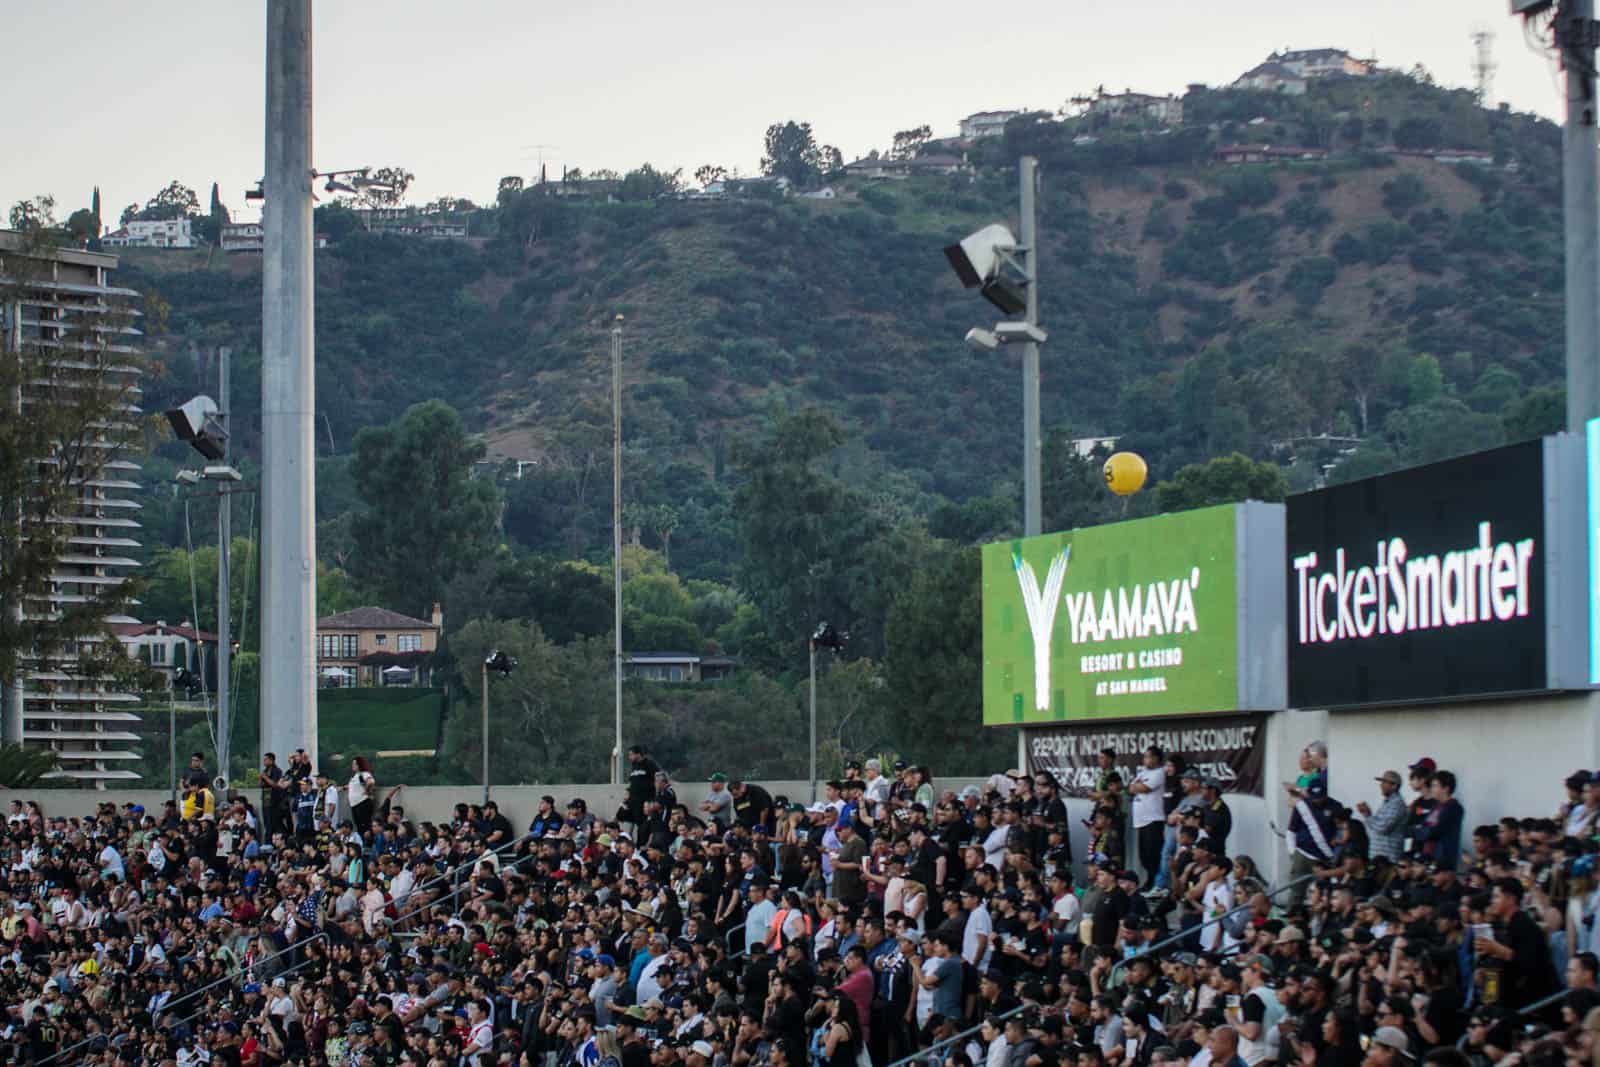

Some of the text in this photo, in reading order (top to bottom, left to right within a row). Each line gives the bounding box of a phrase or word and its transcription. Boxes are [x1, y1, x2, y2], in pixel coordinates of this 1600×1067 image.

[1294, 522, 1534, 643] TicketSmarter
[1080, 647, 1183, 673] RESORT & CASINO
[1096, 677, 1168, 696] AT SAN MANUEL
[1032, 726, 1257, 757] REPORT INCIDENTS OF FAN MISCONDUCT
